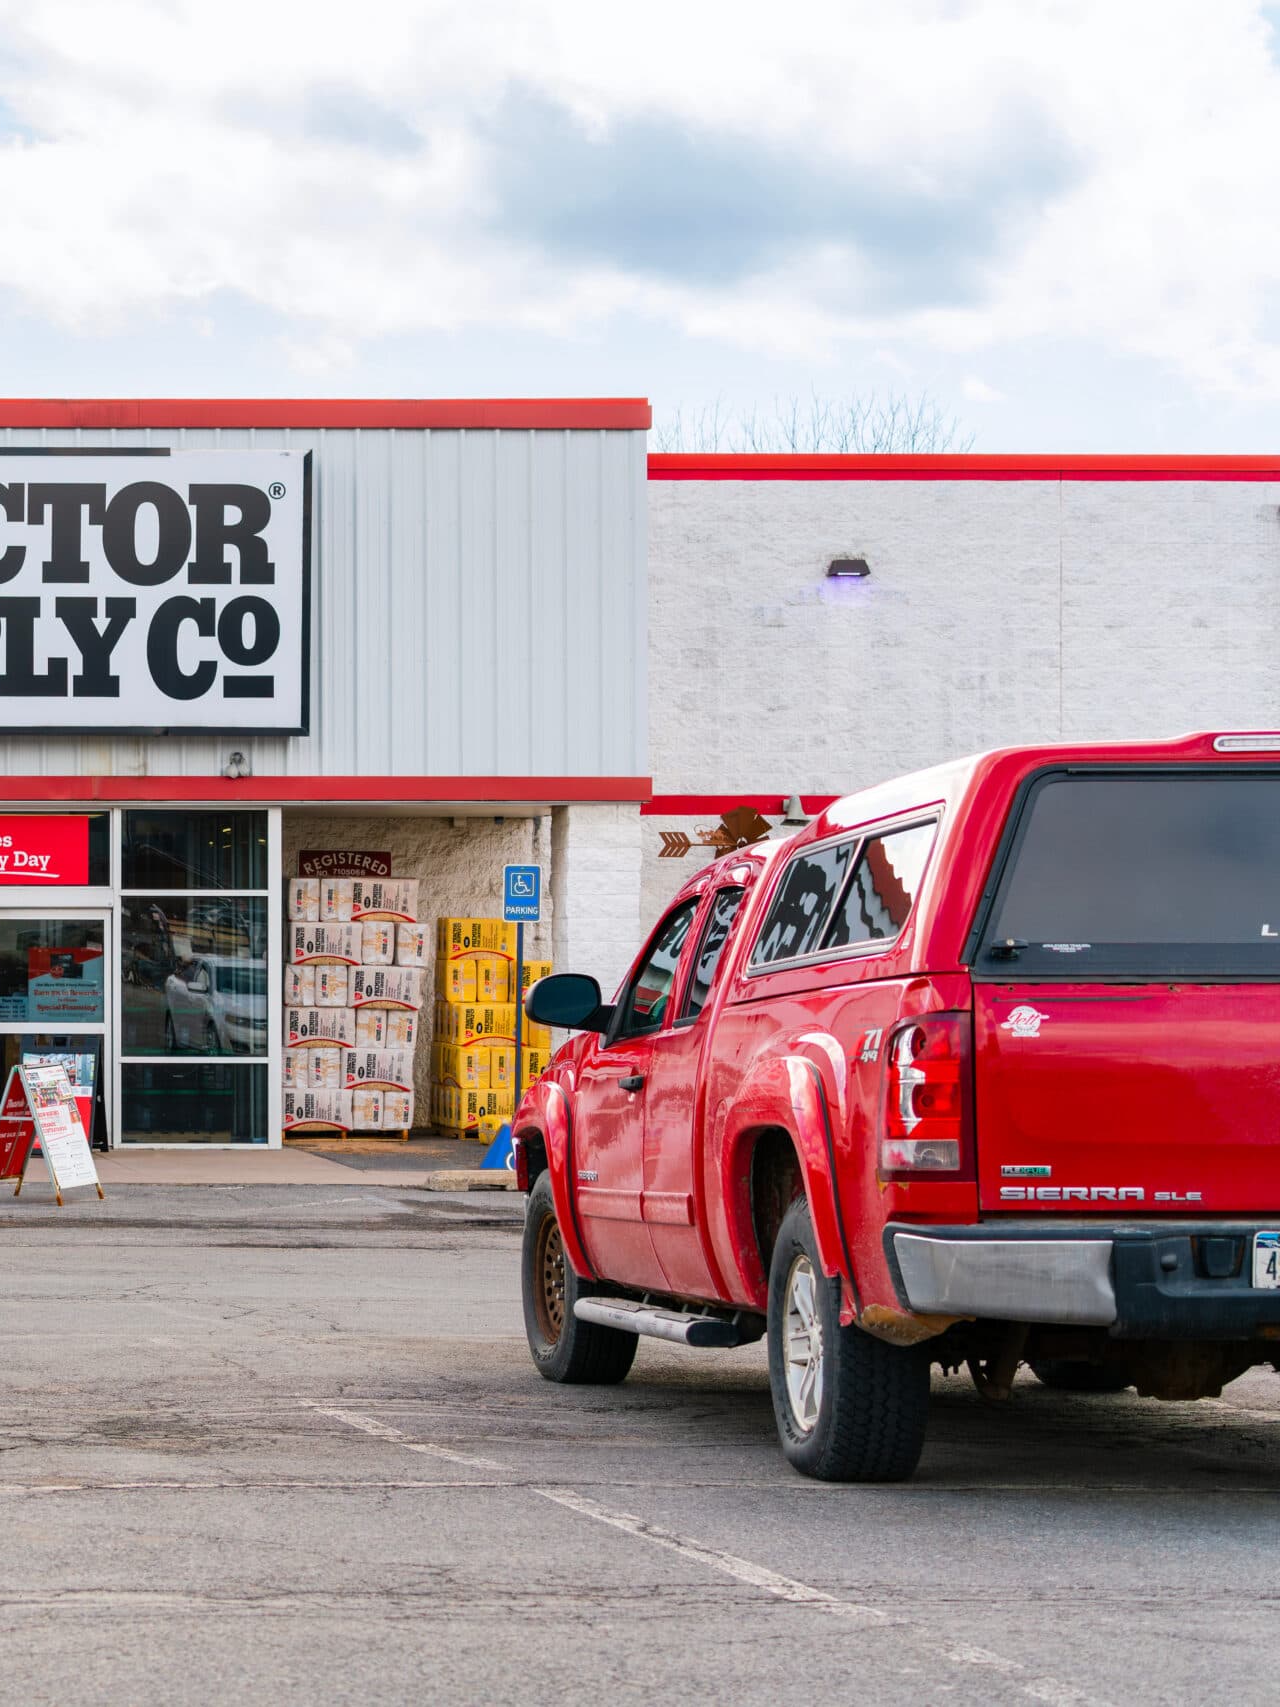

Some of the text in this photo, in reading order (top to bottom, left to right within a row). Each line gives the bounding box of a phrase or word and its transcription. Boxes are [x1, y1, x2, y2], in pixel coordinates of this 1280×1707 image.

[13, 850, 51, 871] Day
[303, 852, 388, 876] REGISTERED
[505, 906, 538, 915] PARKING
[1000, 1187, 1202, 1201] SIERRA SLE
